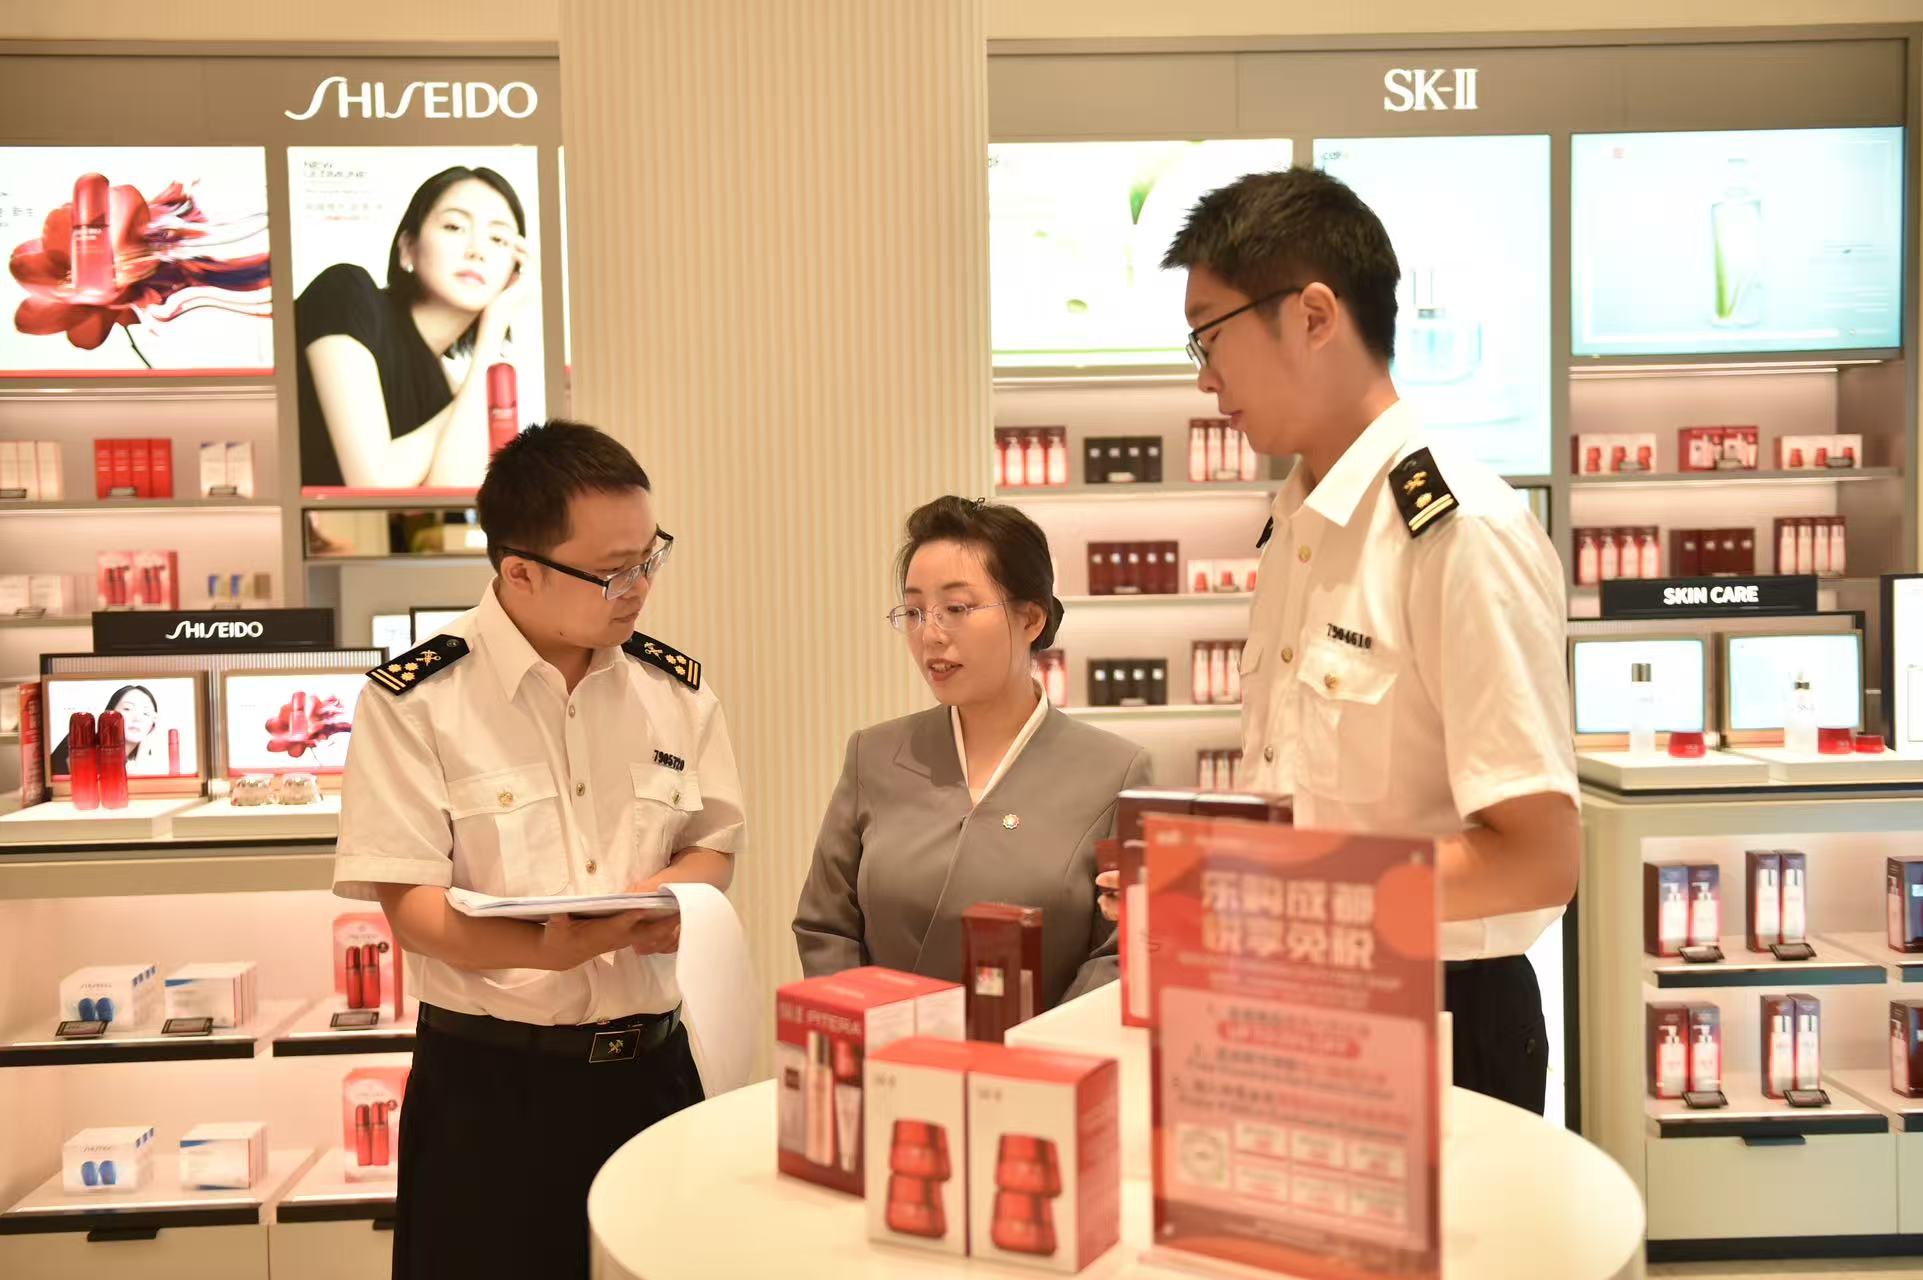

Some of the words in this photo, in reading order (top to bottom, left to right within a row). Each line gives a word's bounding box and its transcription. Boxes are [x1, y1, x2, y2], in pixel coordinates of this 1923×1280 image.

[284, 75, 539, 121] SHISEIDO
[1383, 68, 1480, 112] SK-II
[1663, 586, 1708, 605] SKIN
[1710, 585, 1759, 604] CARE
[165, 620, 264, 640] SHISEIDO
